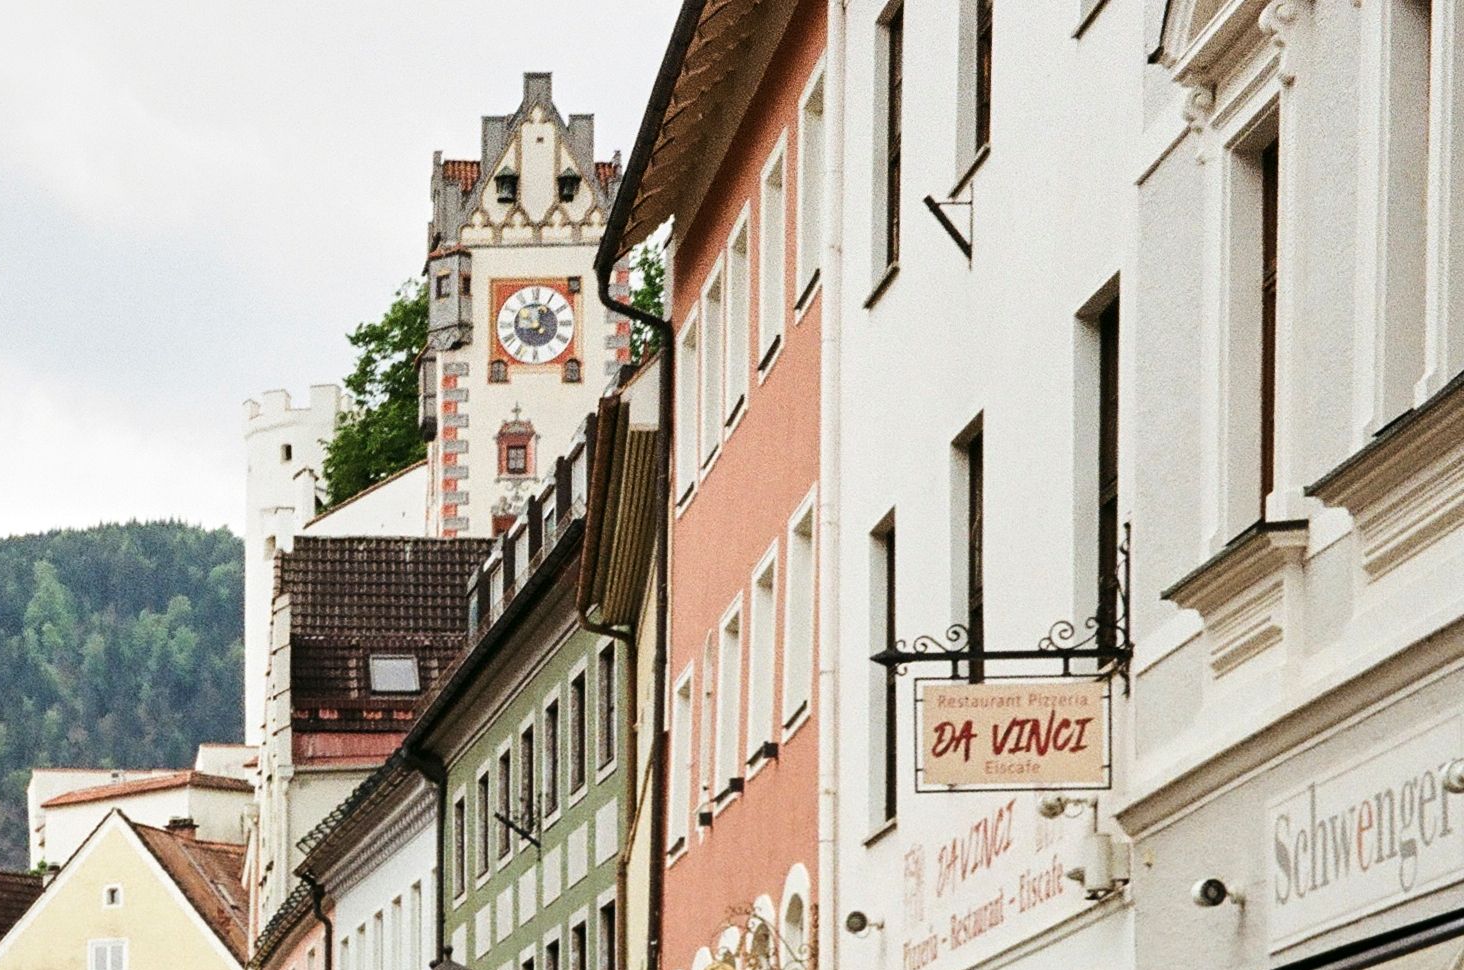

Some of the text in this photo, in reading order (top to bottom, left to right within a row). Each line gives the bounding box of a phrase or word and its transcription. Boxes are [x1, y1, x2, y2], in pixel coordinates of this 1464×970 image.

[937, 692, 1089, 709] Restaurant Pizzeria
[931, 709, 1096, 762] DA VINCI
[985, 760, 1041, 775] Eiscafe
